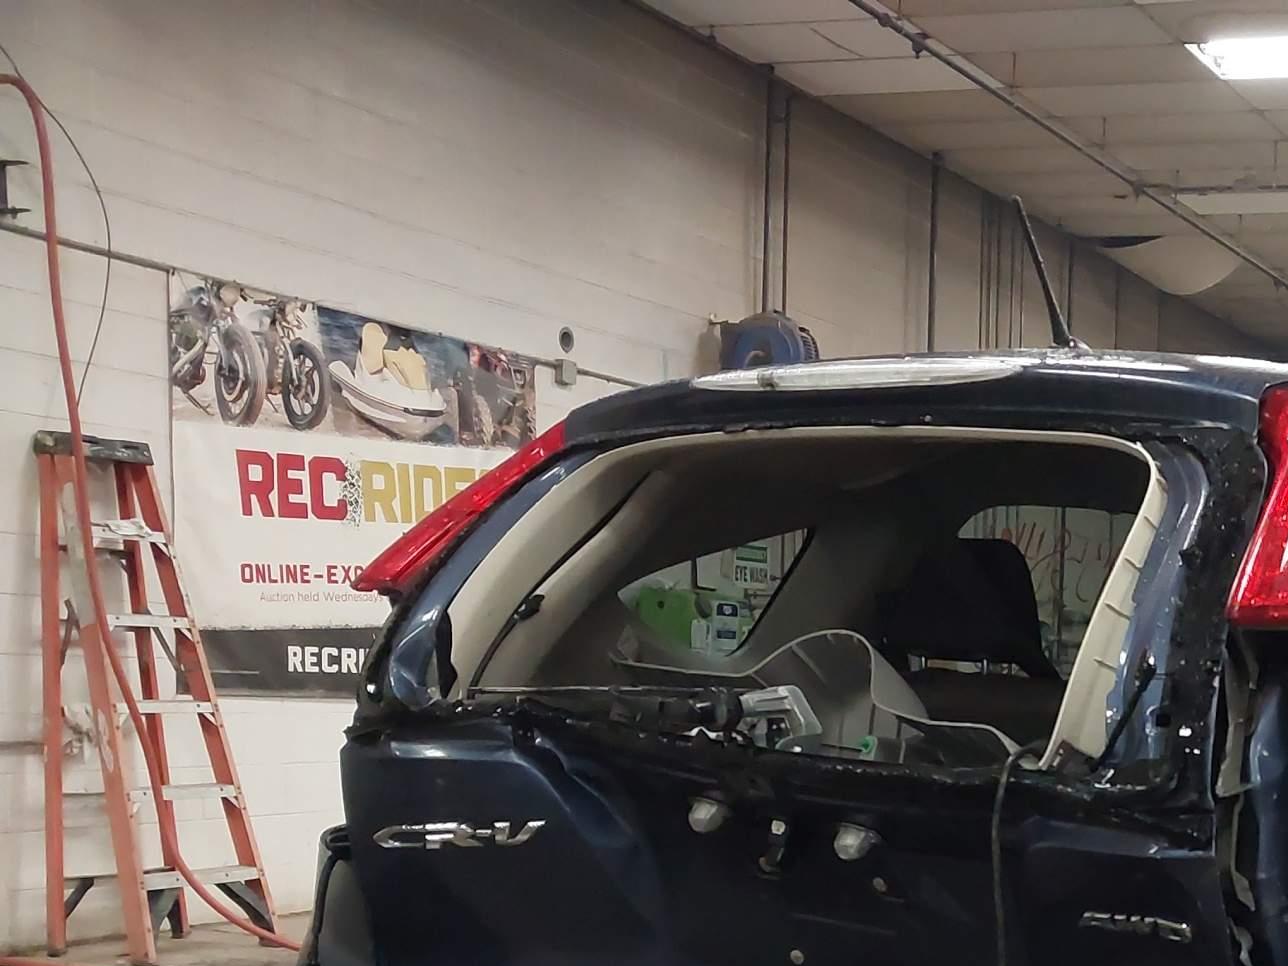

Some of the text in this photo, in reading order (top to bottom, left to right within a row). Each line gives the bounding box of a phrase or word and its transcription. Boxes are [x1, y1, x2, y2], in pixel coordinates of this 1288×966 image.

[236, 449, 492, 524] REC RIDE
[735, 565, 748, 582] EYE
[260, 592, 294, 602] Auction
[297, 591, 320, 602] held
[287, 645, 370, 674] RECRI
[372, 820, 546, 850] CR-V
